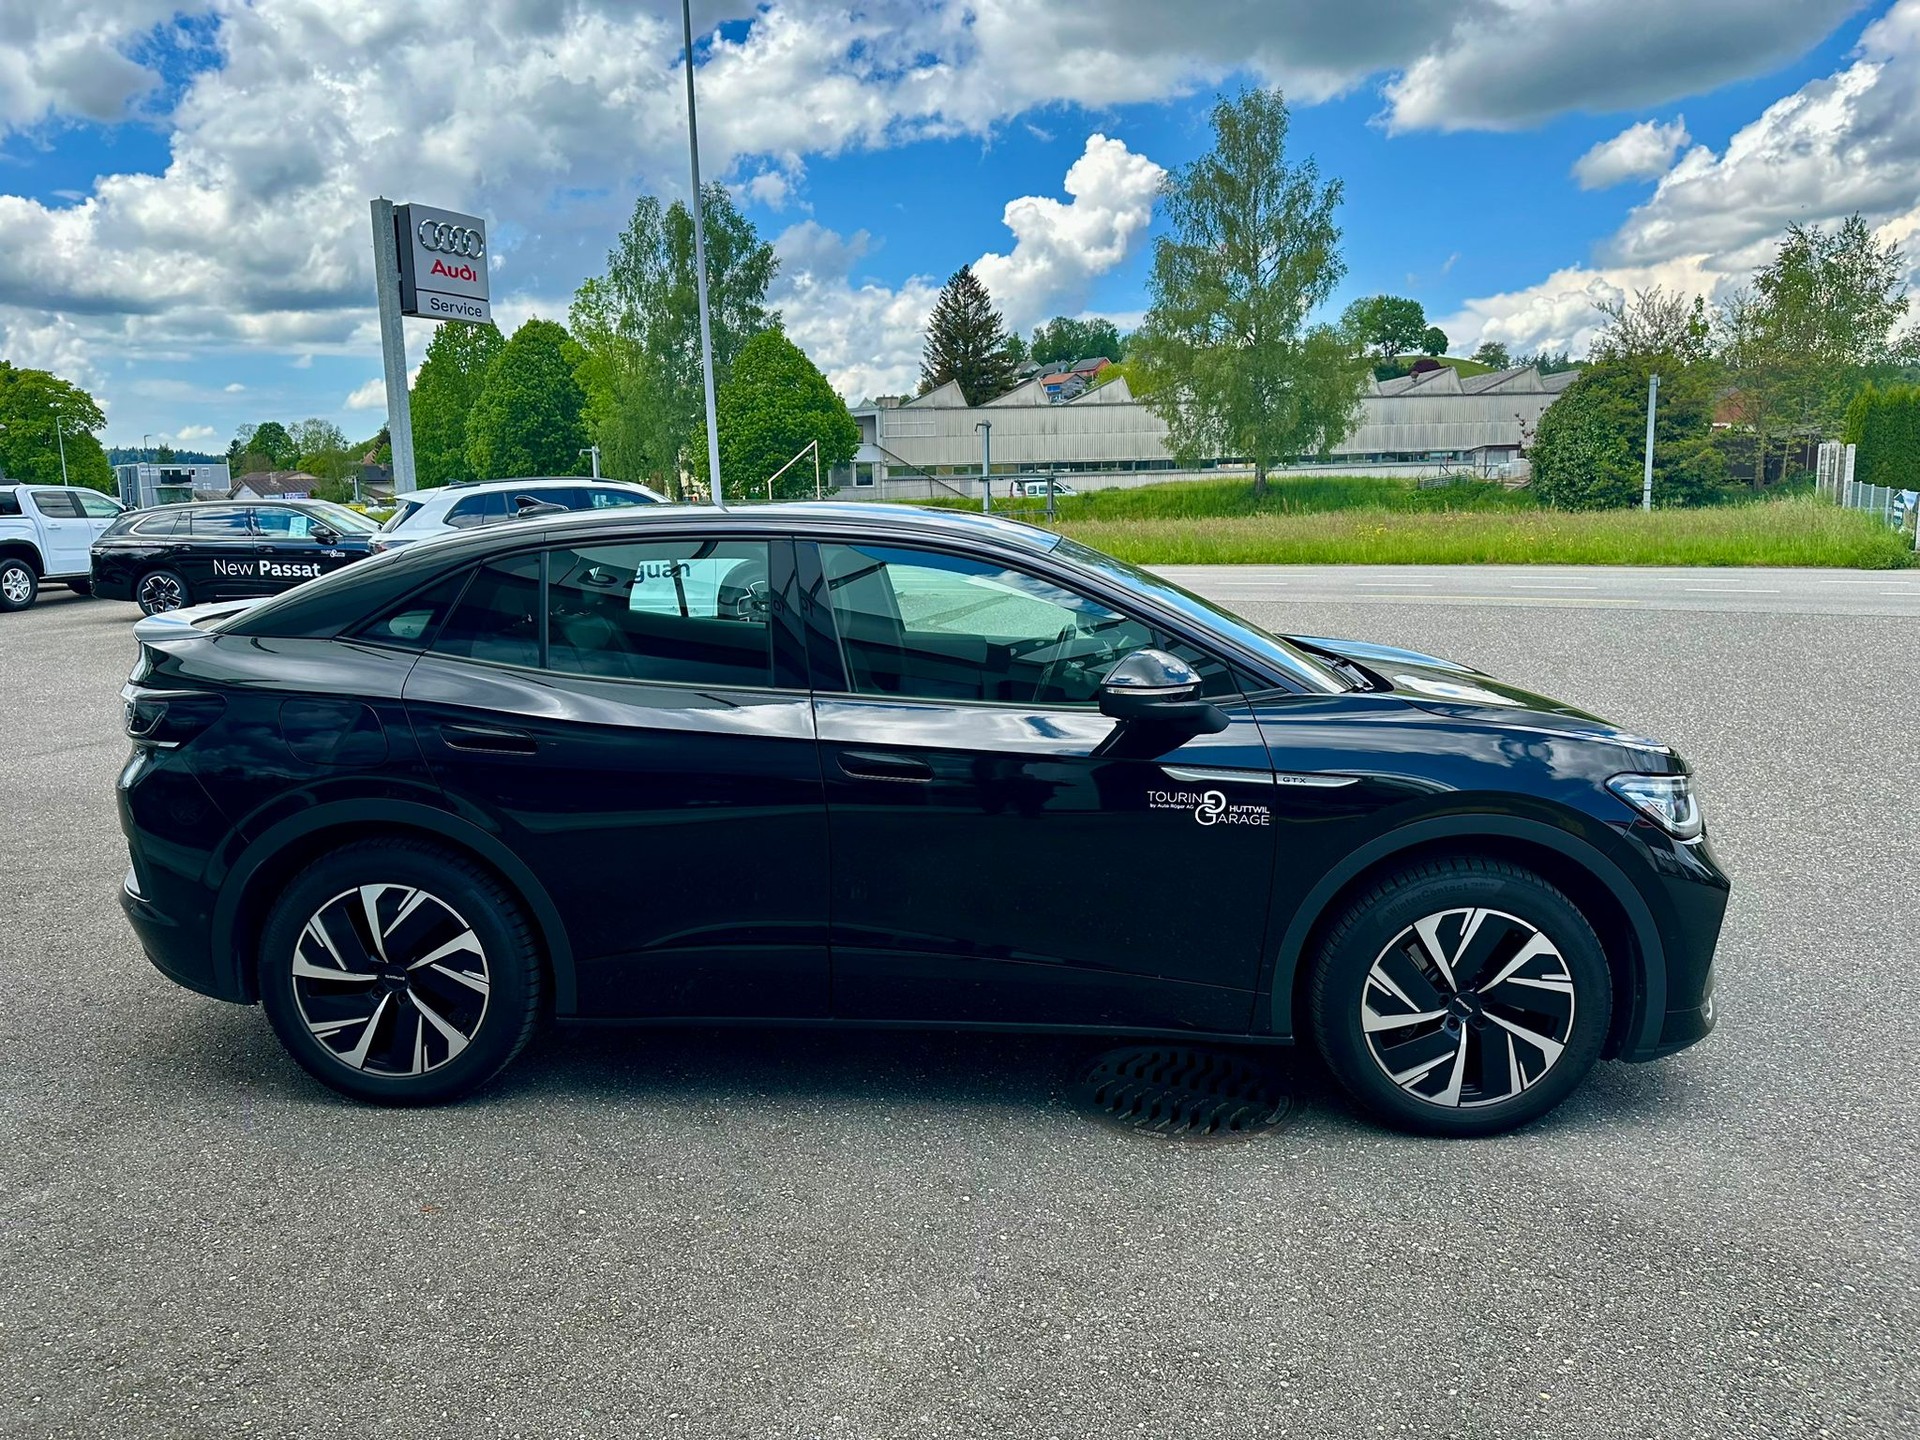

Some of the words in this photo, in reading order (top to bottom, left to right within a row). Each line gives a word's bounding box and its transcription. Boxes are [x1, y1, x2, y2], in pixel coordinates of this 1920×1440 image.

[431, 259, 477, 282] Audi
[430, 297, 482, 317] Service
[213, 560, 253, 576] New
[259, 560, 321, 578] Passat
[1283, 776, 1307, 784] GTX
[1195, 803, 1270, 826] GARAGE
[1229, 805, 1270, 814] HUTTWIL
